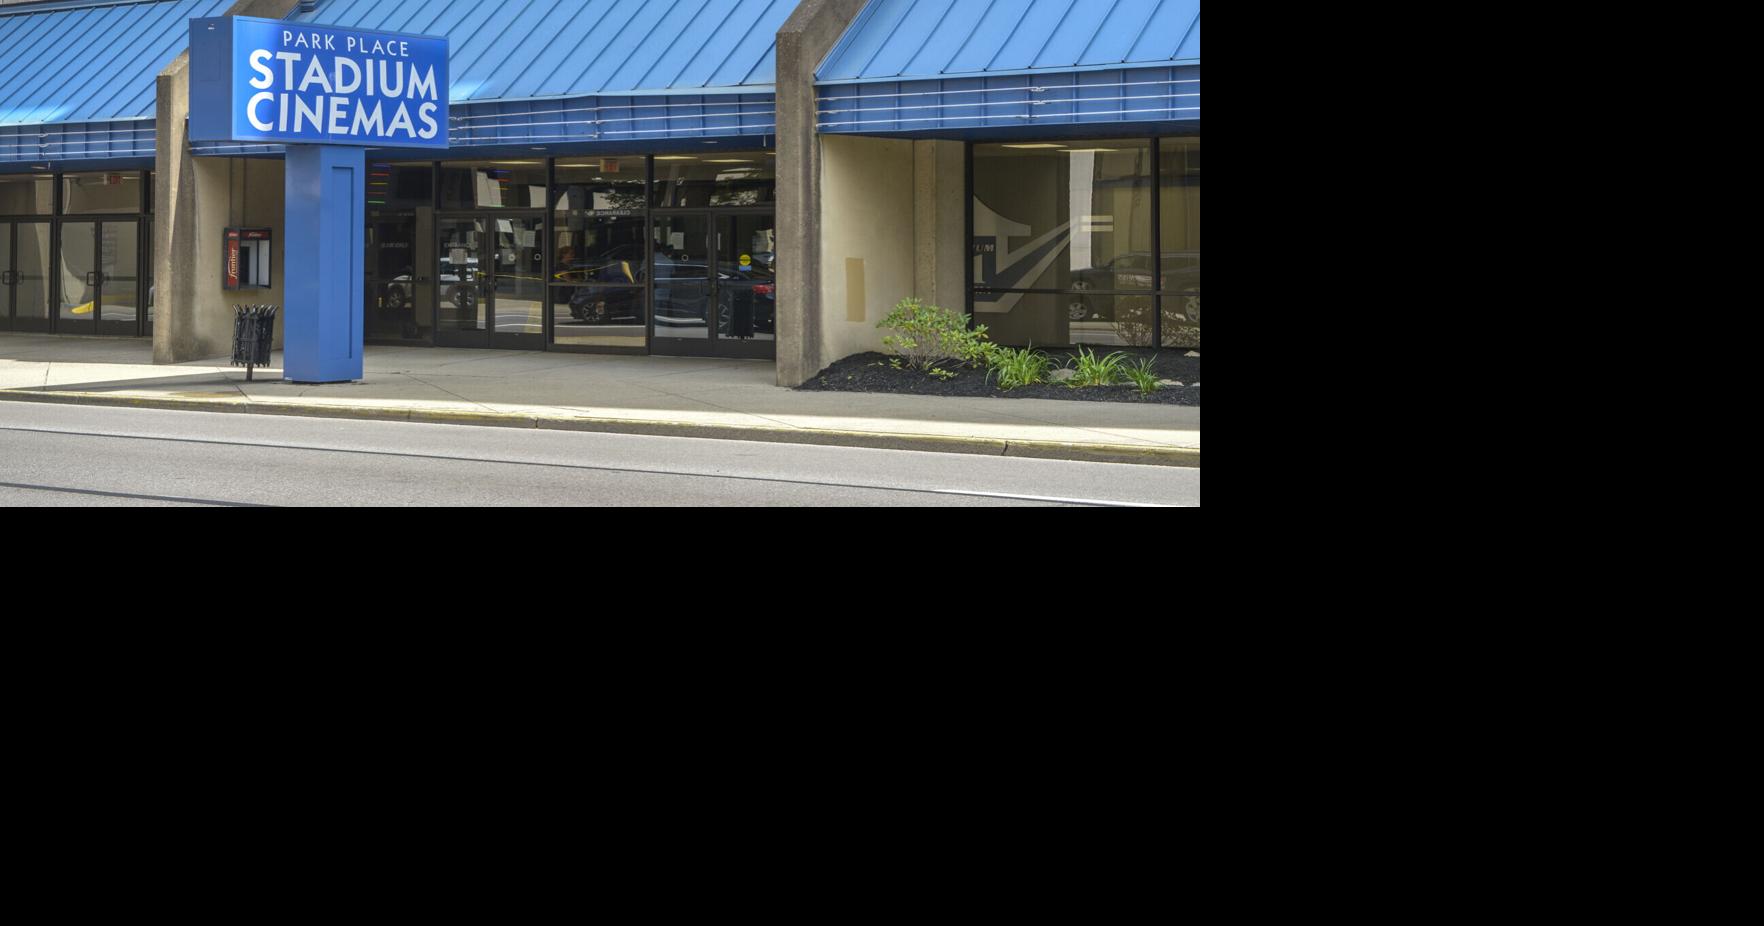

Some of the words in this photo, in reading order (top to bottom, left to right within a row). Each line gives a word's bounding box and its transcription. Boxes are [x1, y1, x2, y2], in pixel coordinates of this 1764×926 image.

[283, 30, 336, 51] PARK
[347, 36, 409, 57] PLACE
[249, 49, 438, 100] STADIUM
[246, 91, 438, 140] CINEMAS
